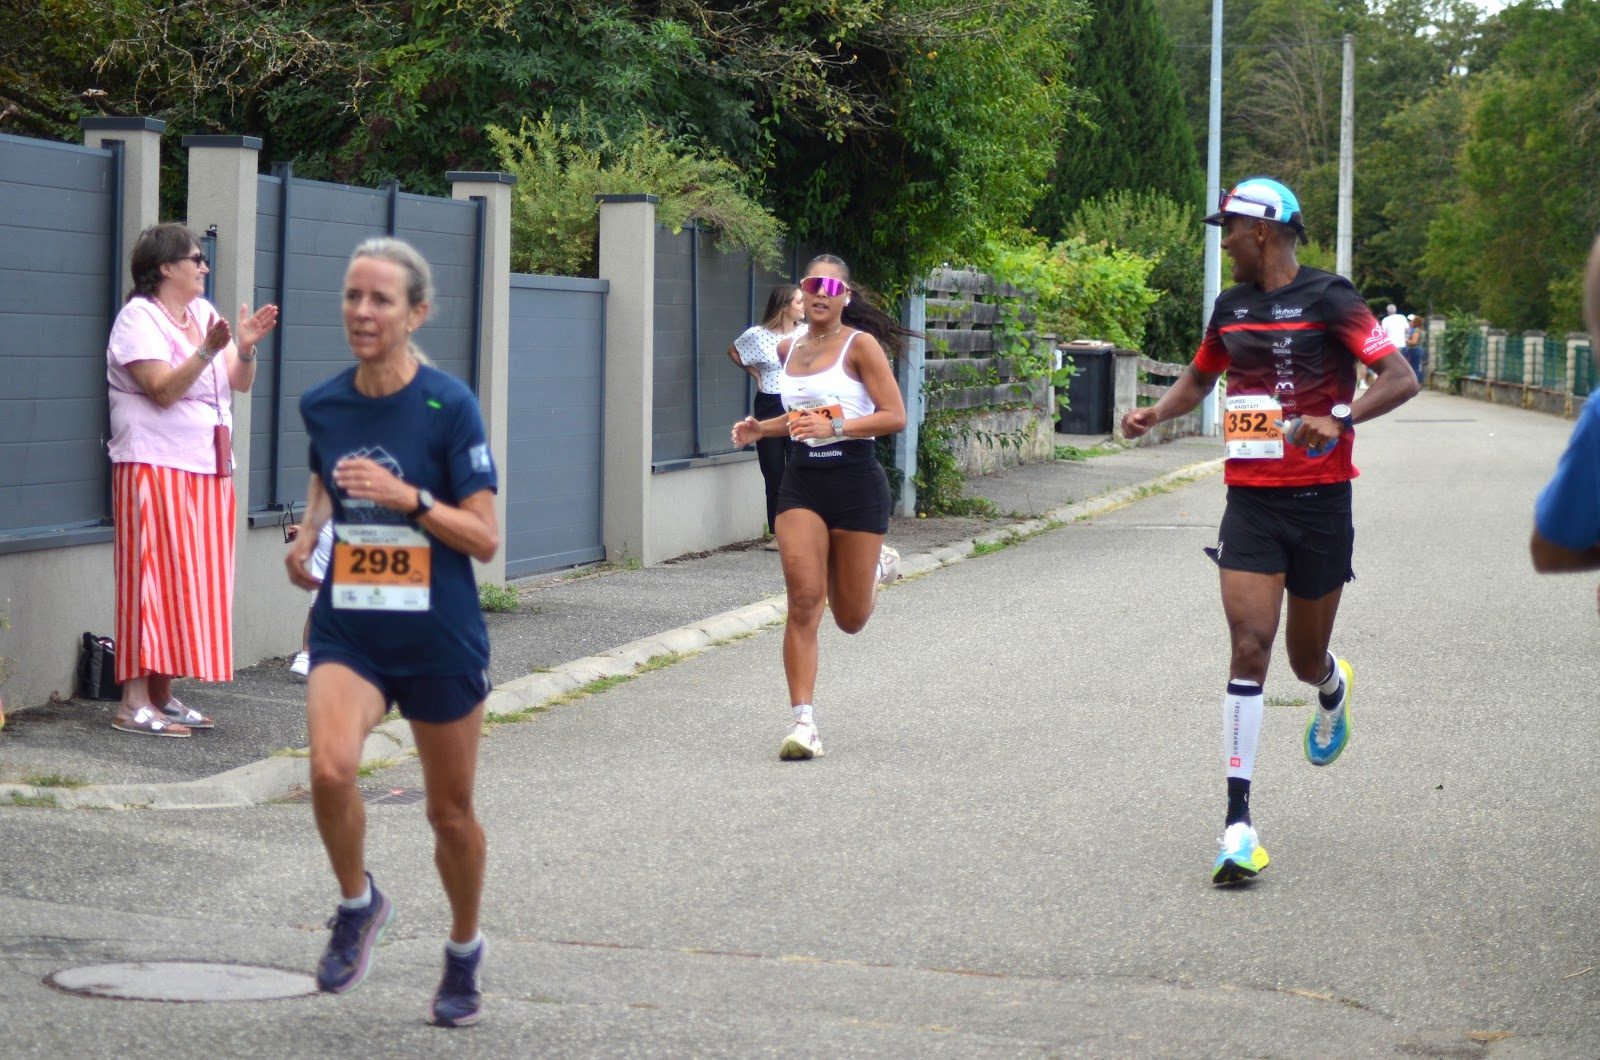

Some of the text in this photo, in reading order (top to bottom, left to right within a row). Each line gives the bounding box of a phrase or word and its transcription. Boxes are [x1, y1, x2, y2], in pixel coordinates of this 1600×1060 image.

[1228, 412, 1268, 433] 352
[808, 450, 842, 458] SALOMON
[350, 548, 411, 576] 298
[1233, 701, 1241, 755] COMPRESSPORT
